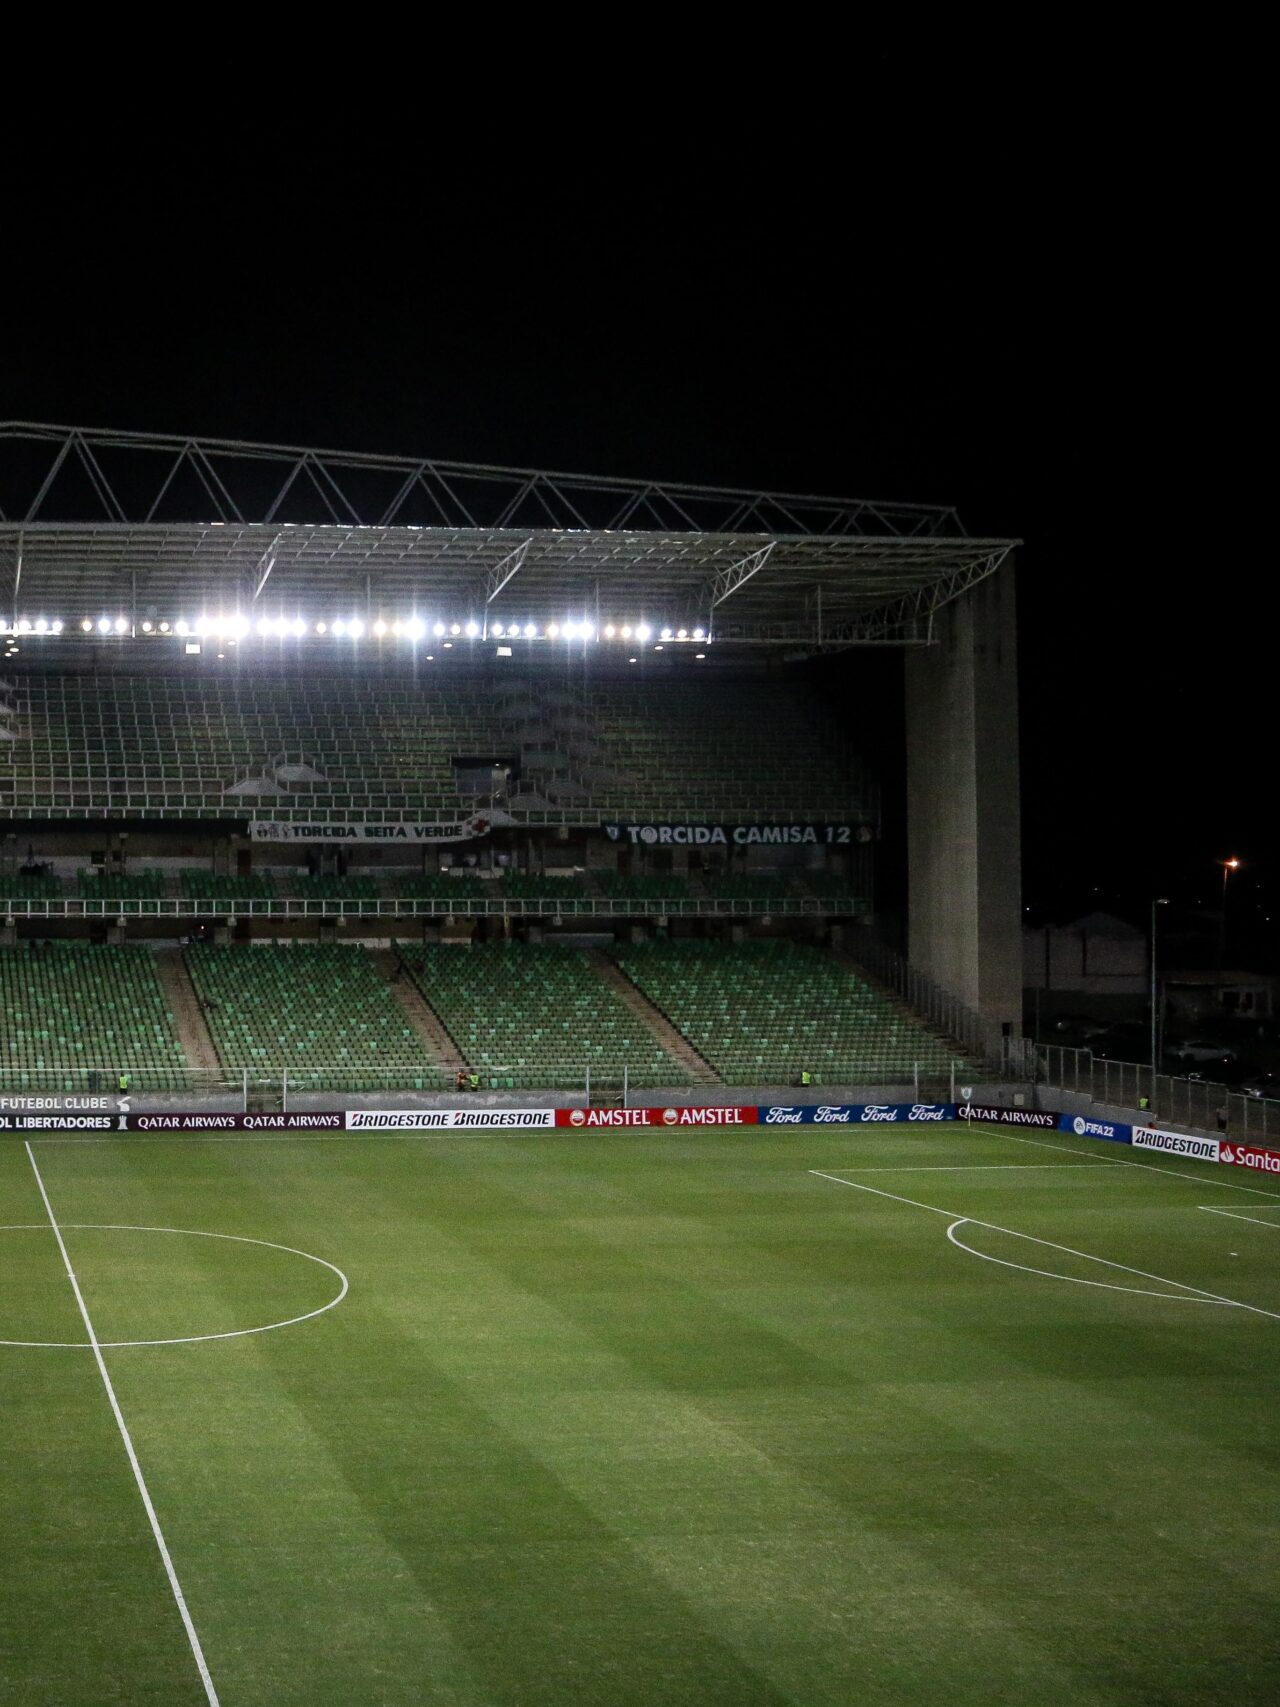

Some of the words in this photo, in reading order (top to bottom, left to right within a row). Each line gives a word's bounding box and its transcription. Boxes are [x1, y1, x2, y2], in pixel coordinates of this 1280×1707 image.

[291, 826, 358, 838] TORCIDA
[364, 826, 407, 838] SEITA
[414, 824, 463, 838] VERDE
[627, 826, 726, 844] TORCIDA
[732, 825, 819, 844] CAMISA
[824, 825, 852, 843] 12
[1, 1097, 61, 1110] FUTEBOL
[65, 1096, 108, 1110] CLUBE
[15, 1115, 112, 1129] LIBERTADORES
[351, 1113, 450, 1127] BRIDGESTONE
[453, 1112, 551, 1126] BRIDGESTONE
[587, 1109, 651, 1126] AMSTEL
[679, 1108, 743, 1125] AMSTEL
[765, 1106, 803, 1124] Ford
[813, 1105, 851, 1123] Ford
[860, 1104, 898, 1122] Ford
[908, 1104, 945, 1121] Ford
[958, 1106, 999, 1121] QATAR
[1000, 1111, 1054, 1126] AIRWAYS
[137, 1116, 180, 1130] QATAR
[182, 1116, 236, 1128] AIRWAYS
[243, 1116, 285, 1129] QATAR
[287, 1115, 340, 1127] AIRWAYS
[1134, 1129, 1218, 1158] BRIDGESTONE
